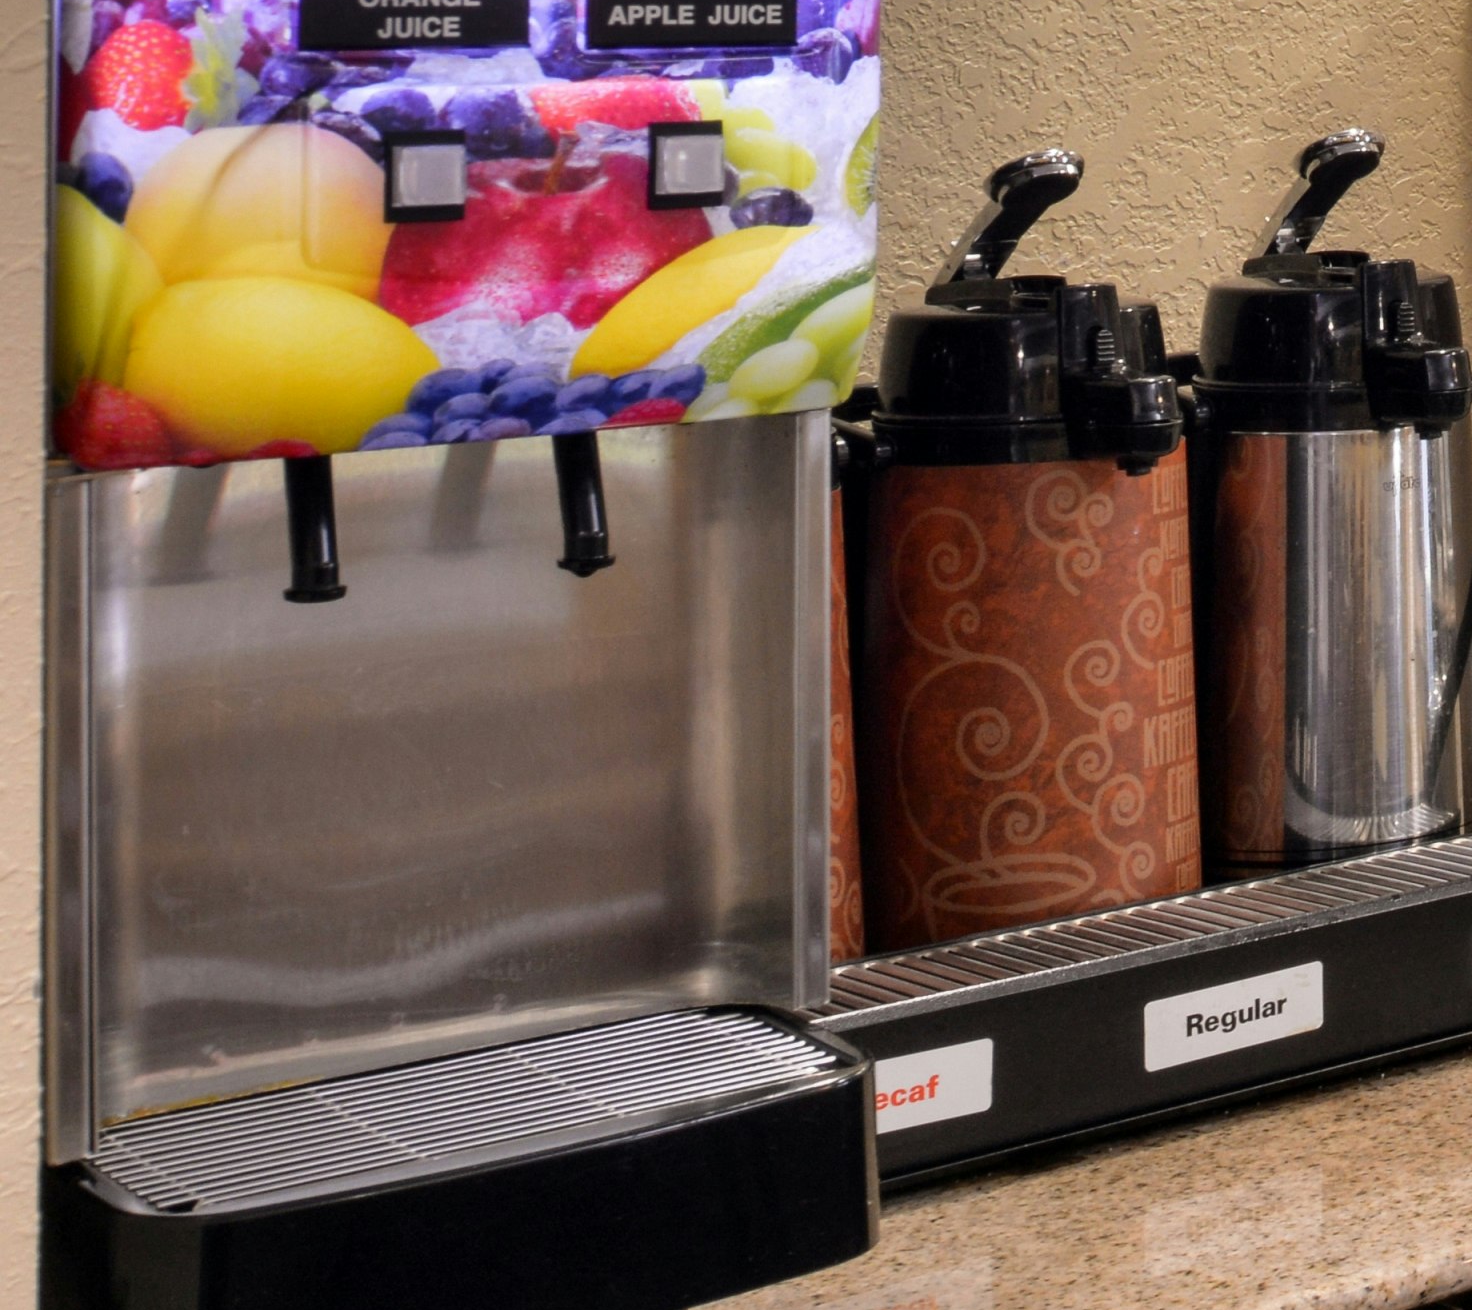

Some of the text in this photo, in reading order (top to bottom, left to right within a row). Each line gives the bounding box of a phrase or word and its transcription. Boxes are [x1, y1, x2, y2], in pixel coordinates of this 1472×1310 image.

[376, 16, 461, 40] JUICE
[607, 4, 783, 27] APPLE JUICE
[1185, 997, 1288, 1038] Regular
[875, 1074, 940, 1110] ecaf
